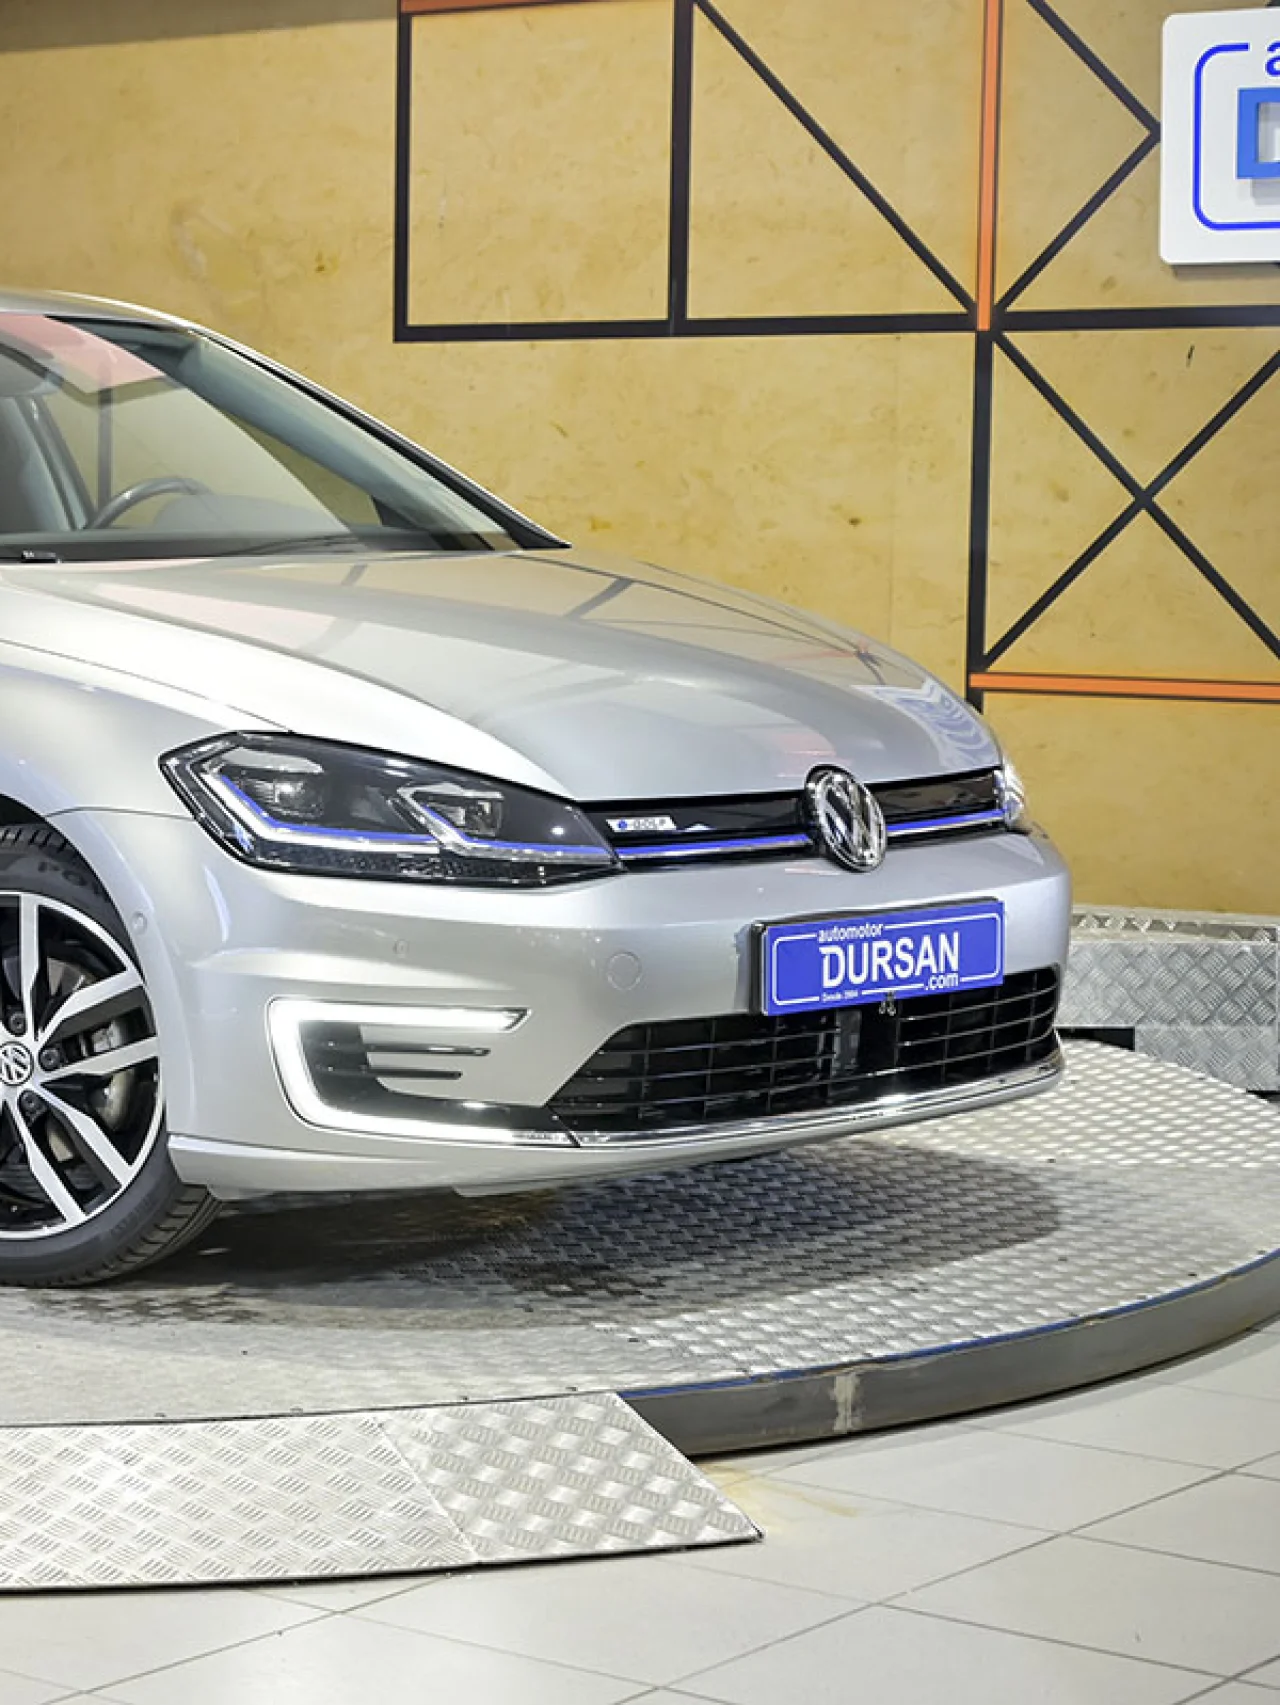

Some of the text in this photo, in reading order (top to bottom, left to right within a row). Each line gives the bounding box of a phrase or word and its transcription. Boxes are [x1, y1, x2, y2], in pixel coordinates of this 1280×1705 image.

[817, 922, 885, 943] automotor
[818, 931, 960, 989] DURSAN
[924, 972, 959, 991] .com
